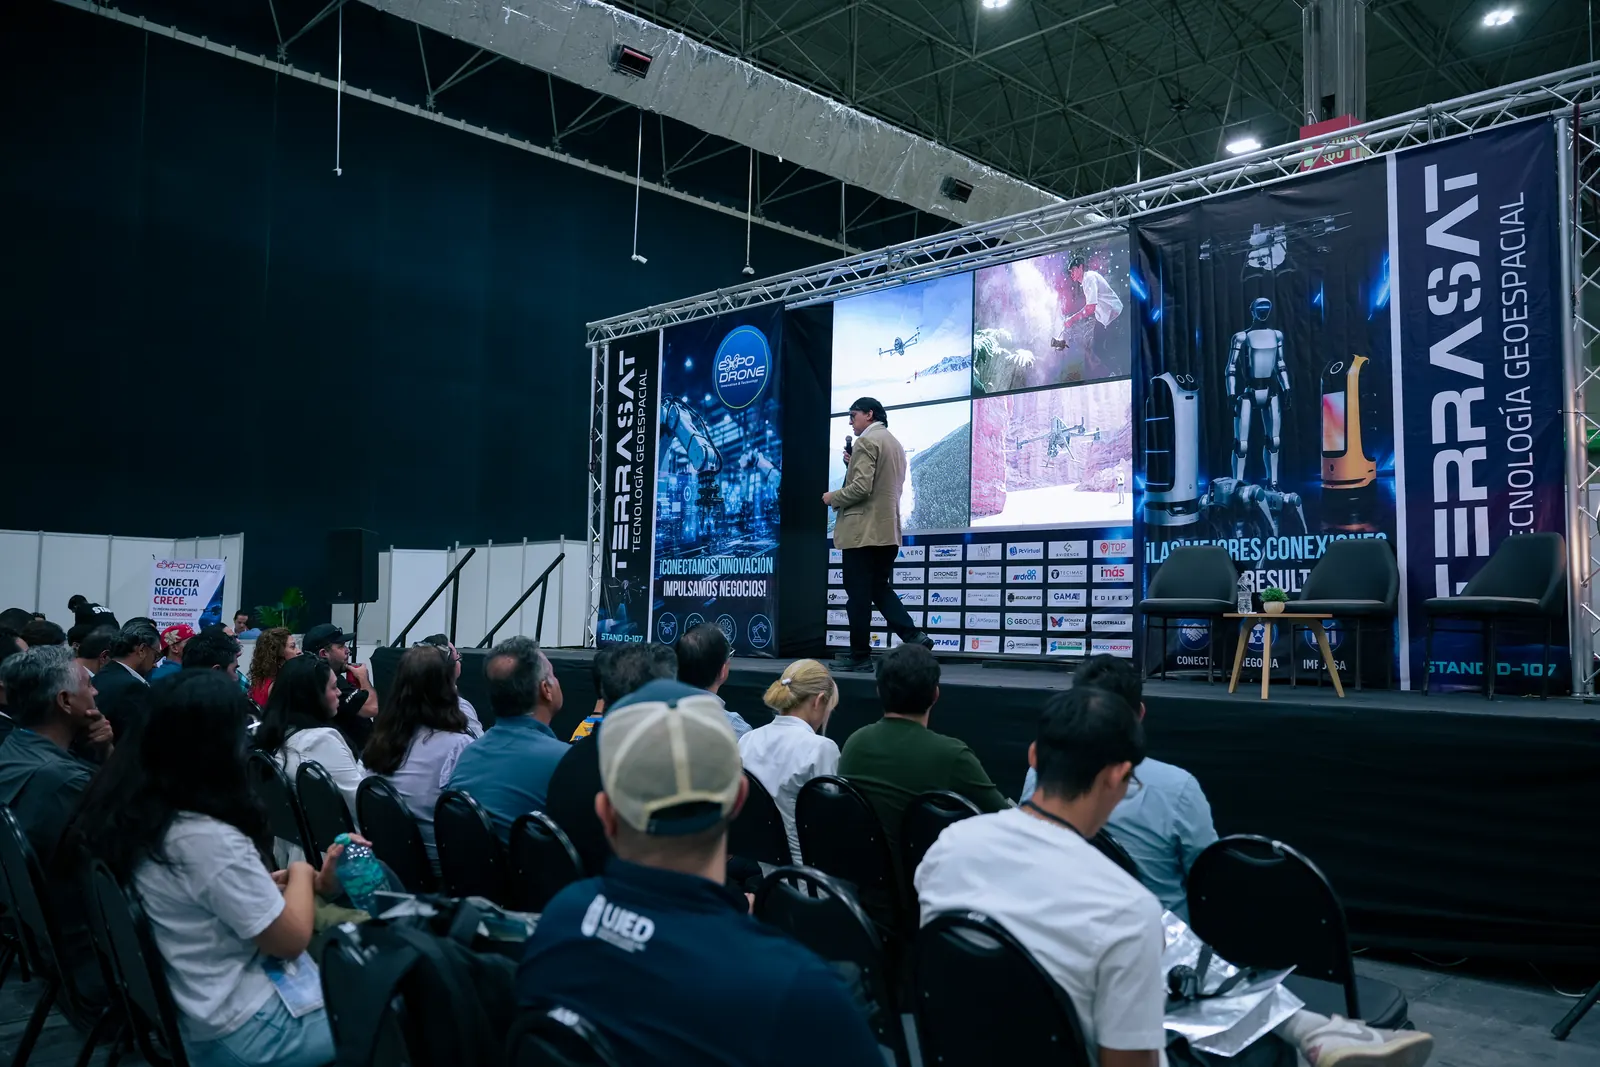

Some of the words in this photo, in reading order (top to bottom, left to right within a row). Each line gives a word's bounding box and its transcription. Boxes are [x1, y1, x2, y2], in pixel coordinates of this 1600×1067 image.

[1499, 192, 1530, 379] GEOESPACIAL
[718, 353, 755, 372] EXPO
[719, 365, 765, 383] DRONE
[636, 369, 647, 463] GEOESPACIAL
[611, 350, 635, 577] TERRASAT
[1498, 385, 1534, 536] CNOLOGÍA
[632, 465, 644, 552] TECNOLOGÍA
[1111, 542, 1127, 551] TOP
[719, 554, 773, 574] INNOVACIÓN
[155, 577, 199, 587] CONECTA
[663, 580, 717, 597] IMPULSAMOS
[719, 580, 766, 597] NEGOCIOS!
[1246, 568, 1312, 593] RESULT
[153, 595, 187, 605] CRECE.
[154, 587, 198, 596] NEGOCIA
[601, 632, 623, 642] STAND
[624, 633, 643, 643] D-107
[1176, 655, 1215, 666] CONECT
[1242, 657, 1279, 669] EGOIA
